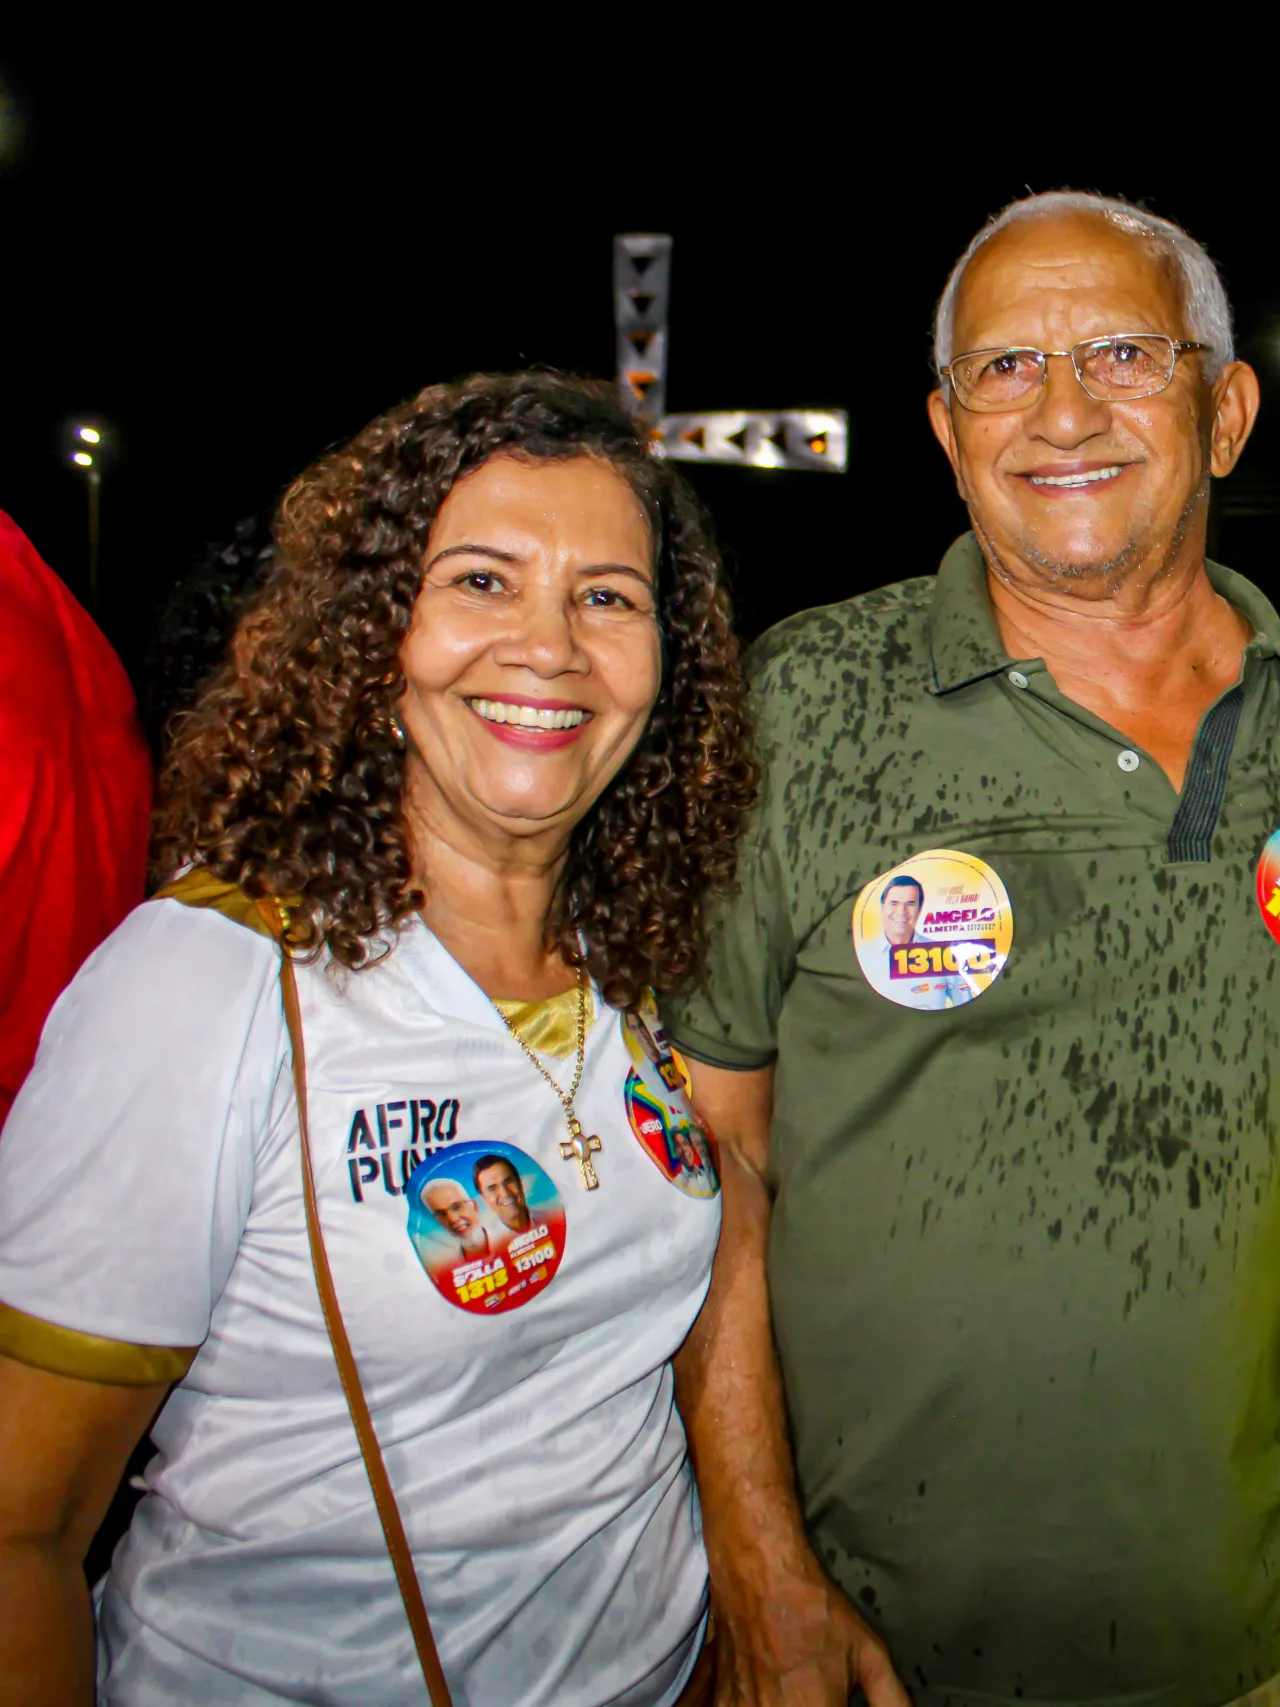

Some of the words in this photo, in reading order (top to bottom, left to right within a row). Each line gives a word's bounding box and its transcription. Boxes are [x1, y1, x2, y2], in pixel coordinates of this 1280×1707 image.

[347, 1099, 460, 1153] AFRO
[515, 1246, 554, 1274] 13100
[456, 1268, 509, 1304] 1313
